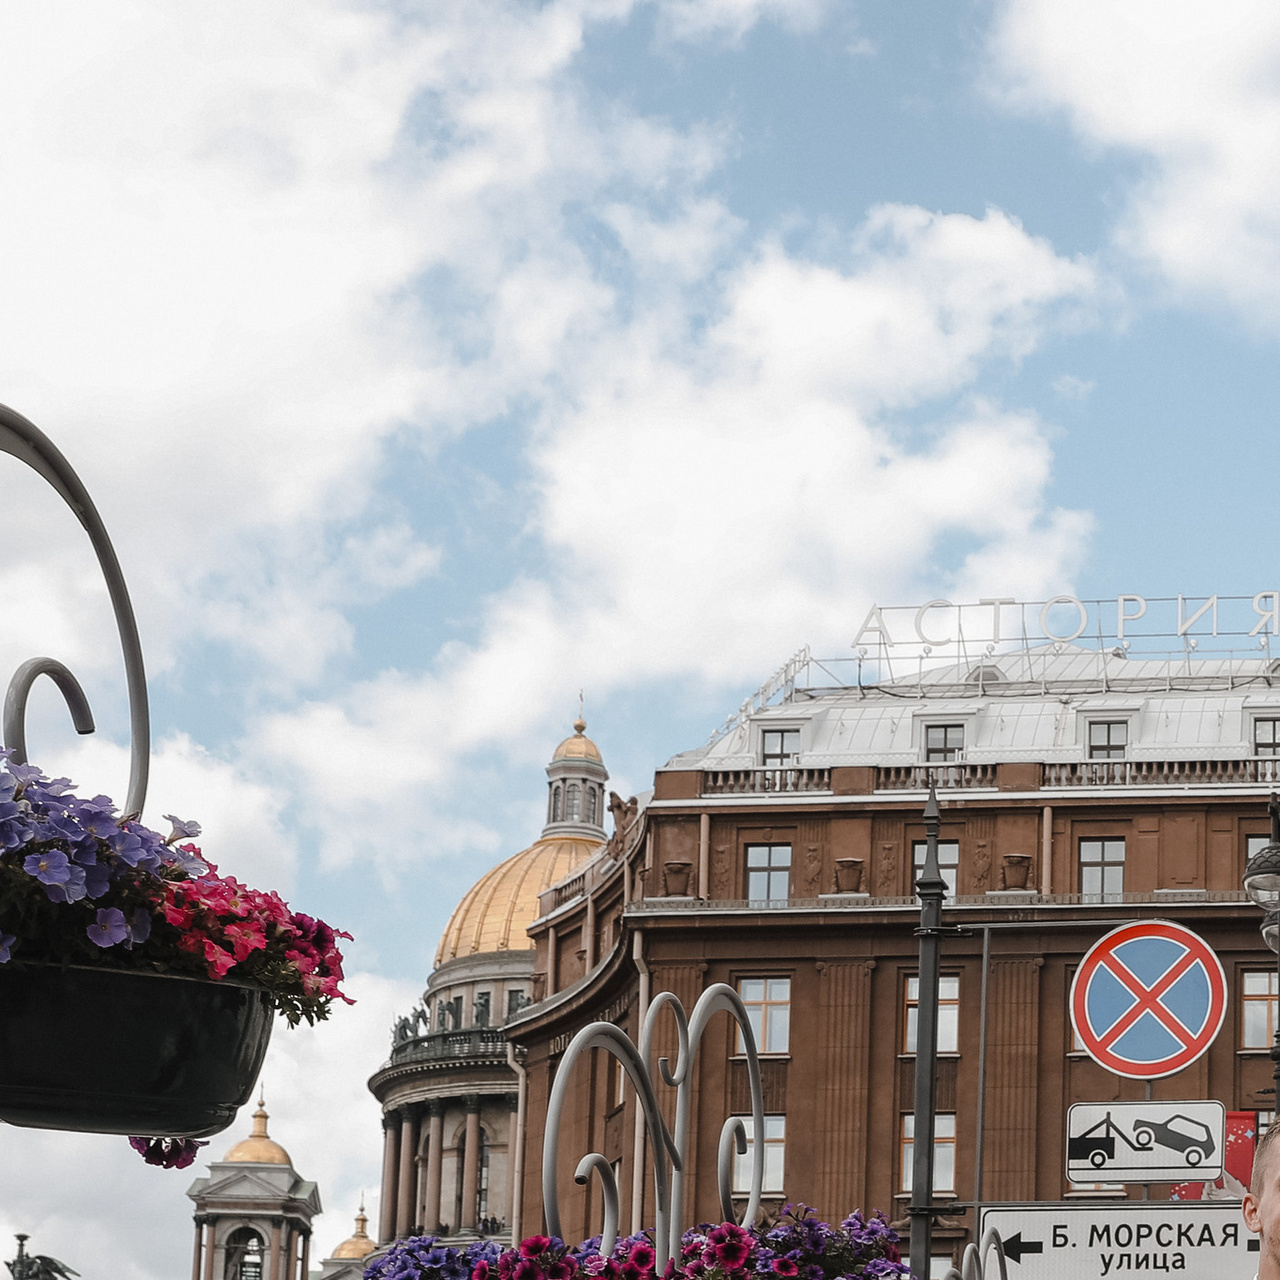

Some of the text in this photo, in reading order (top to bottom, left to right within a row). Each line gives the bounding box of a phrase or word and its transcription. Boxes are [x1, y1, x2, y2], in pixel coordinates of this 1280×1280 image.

[851, 591, 1280, 648] АСТОРИЯ
[1052, 1223, 1239, 1248] Б. МОРСКАЯ
[1100, 1252, 1186, 1277] улица
